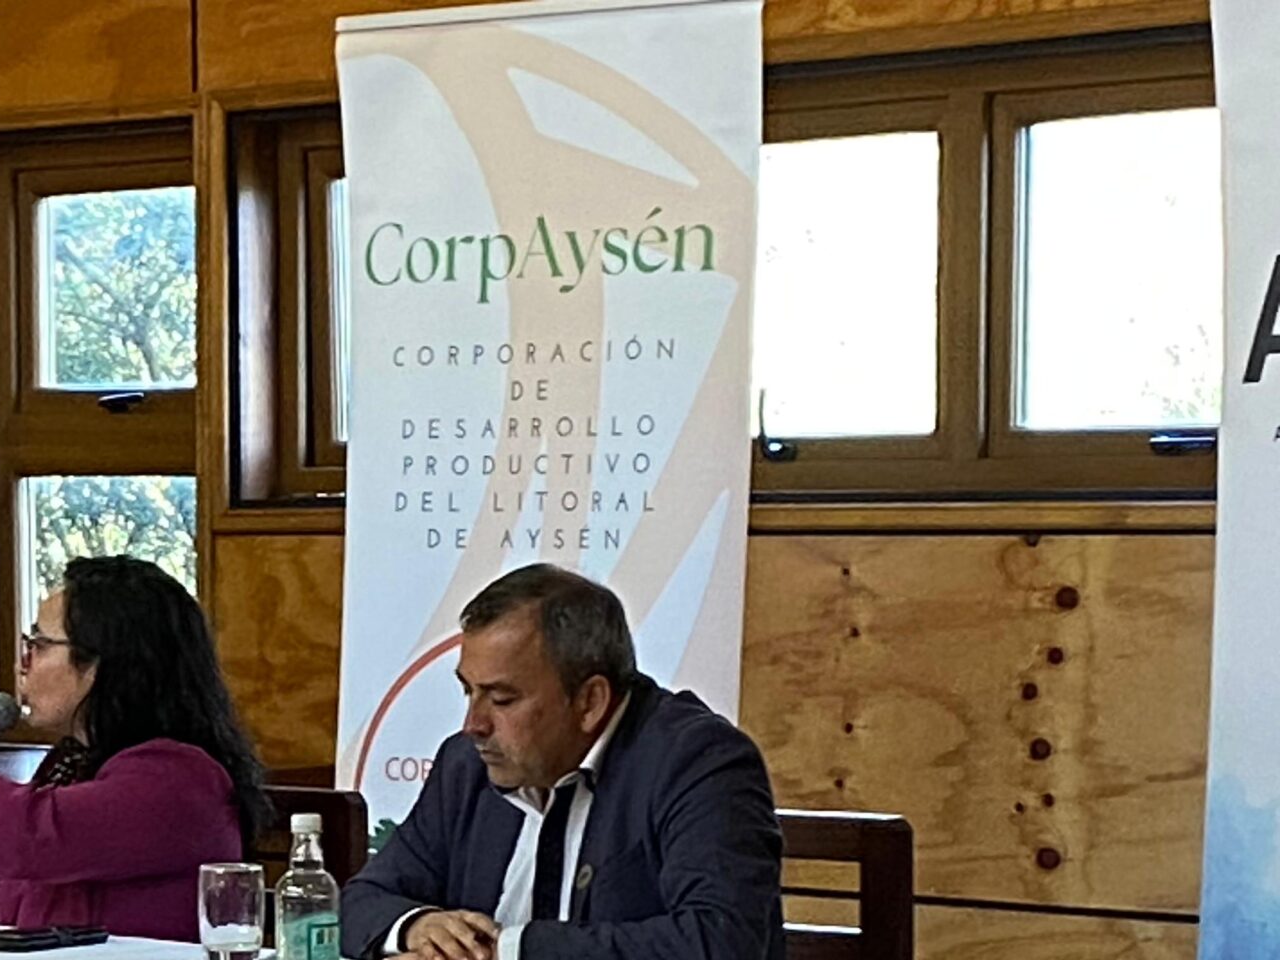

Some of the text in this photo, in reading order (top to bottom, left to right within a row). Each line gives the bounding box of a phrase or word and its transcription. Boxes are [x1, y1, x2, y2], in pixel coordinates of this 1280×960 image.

[365, 207, 715, 304] CorpAysén
[393, 335, 675, 367] CORPORACIÓN
[511, 380, 548, 401] DE
[402, 414, 655, 440] DESARROLLO
[403, 453, 650, 476] PRODUCTIVO
[395, 491, 655, 513] DEL LITORAL
[427, 528, 467, 549] DE
